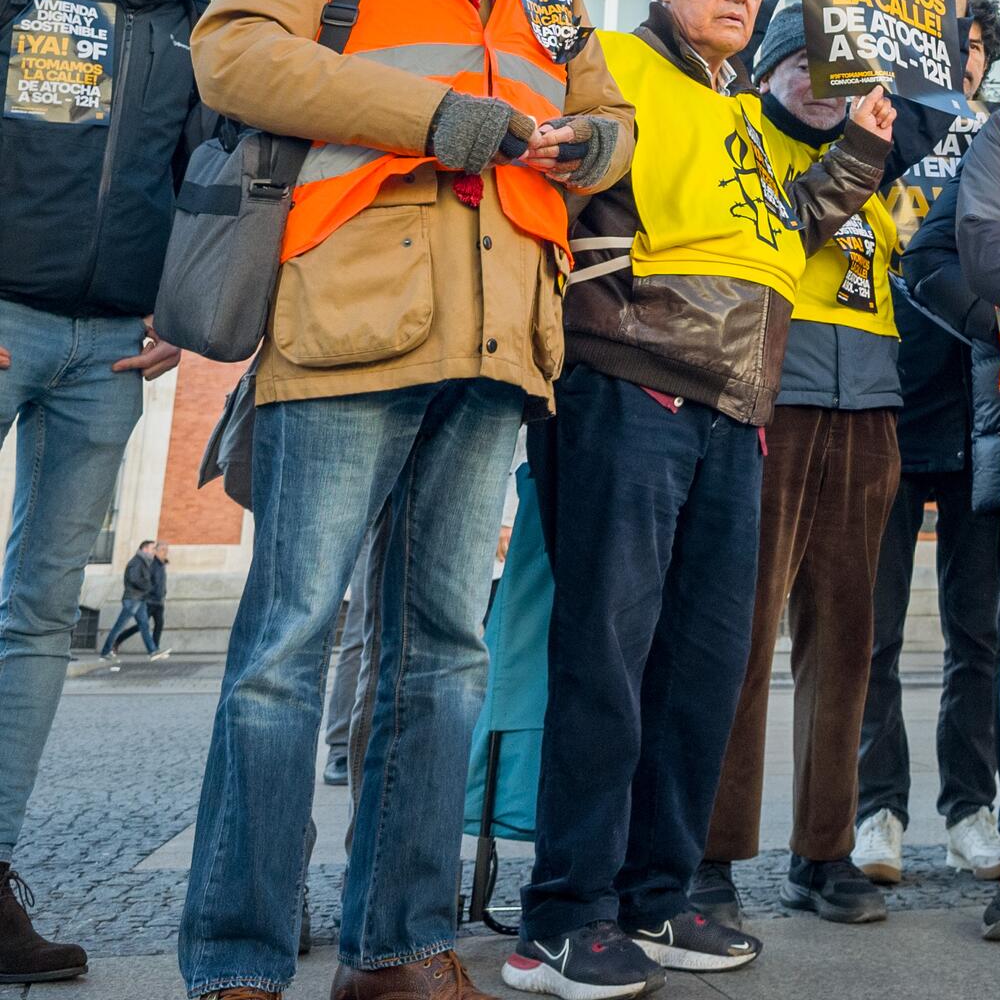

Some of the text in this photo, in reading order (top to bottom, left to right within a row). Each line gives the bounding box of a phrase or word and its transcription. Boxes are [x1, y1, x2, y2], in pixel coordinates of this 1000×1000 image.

[34, 0, 98, 19] VIVIENDA
[38, 10, 94, 27] DIGNA Y
[20, 19, 108, 40] SOSTENIBLE
[823, 6, 951, 66] DE ATOCHA
[17, 34, 108, 60] ¡YA! 9F
[21, 57, 103, 75] ¡TOMAMOS
[829, 34, 854, 62] A
[856, 33, 908, 69] SOL
[920, 56, 952, 90] 12H
[23, 69, 98, 86] LA CALLE!
[18, 80, 101, 97] DE ATOCHA
[18, 91, 31, 102] A
[32, 92, 62, 104] SOL
[74, 96, 99, 108] 12H
